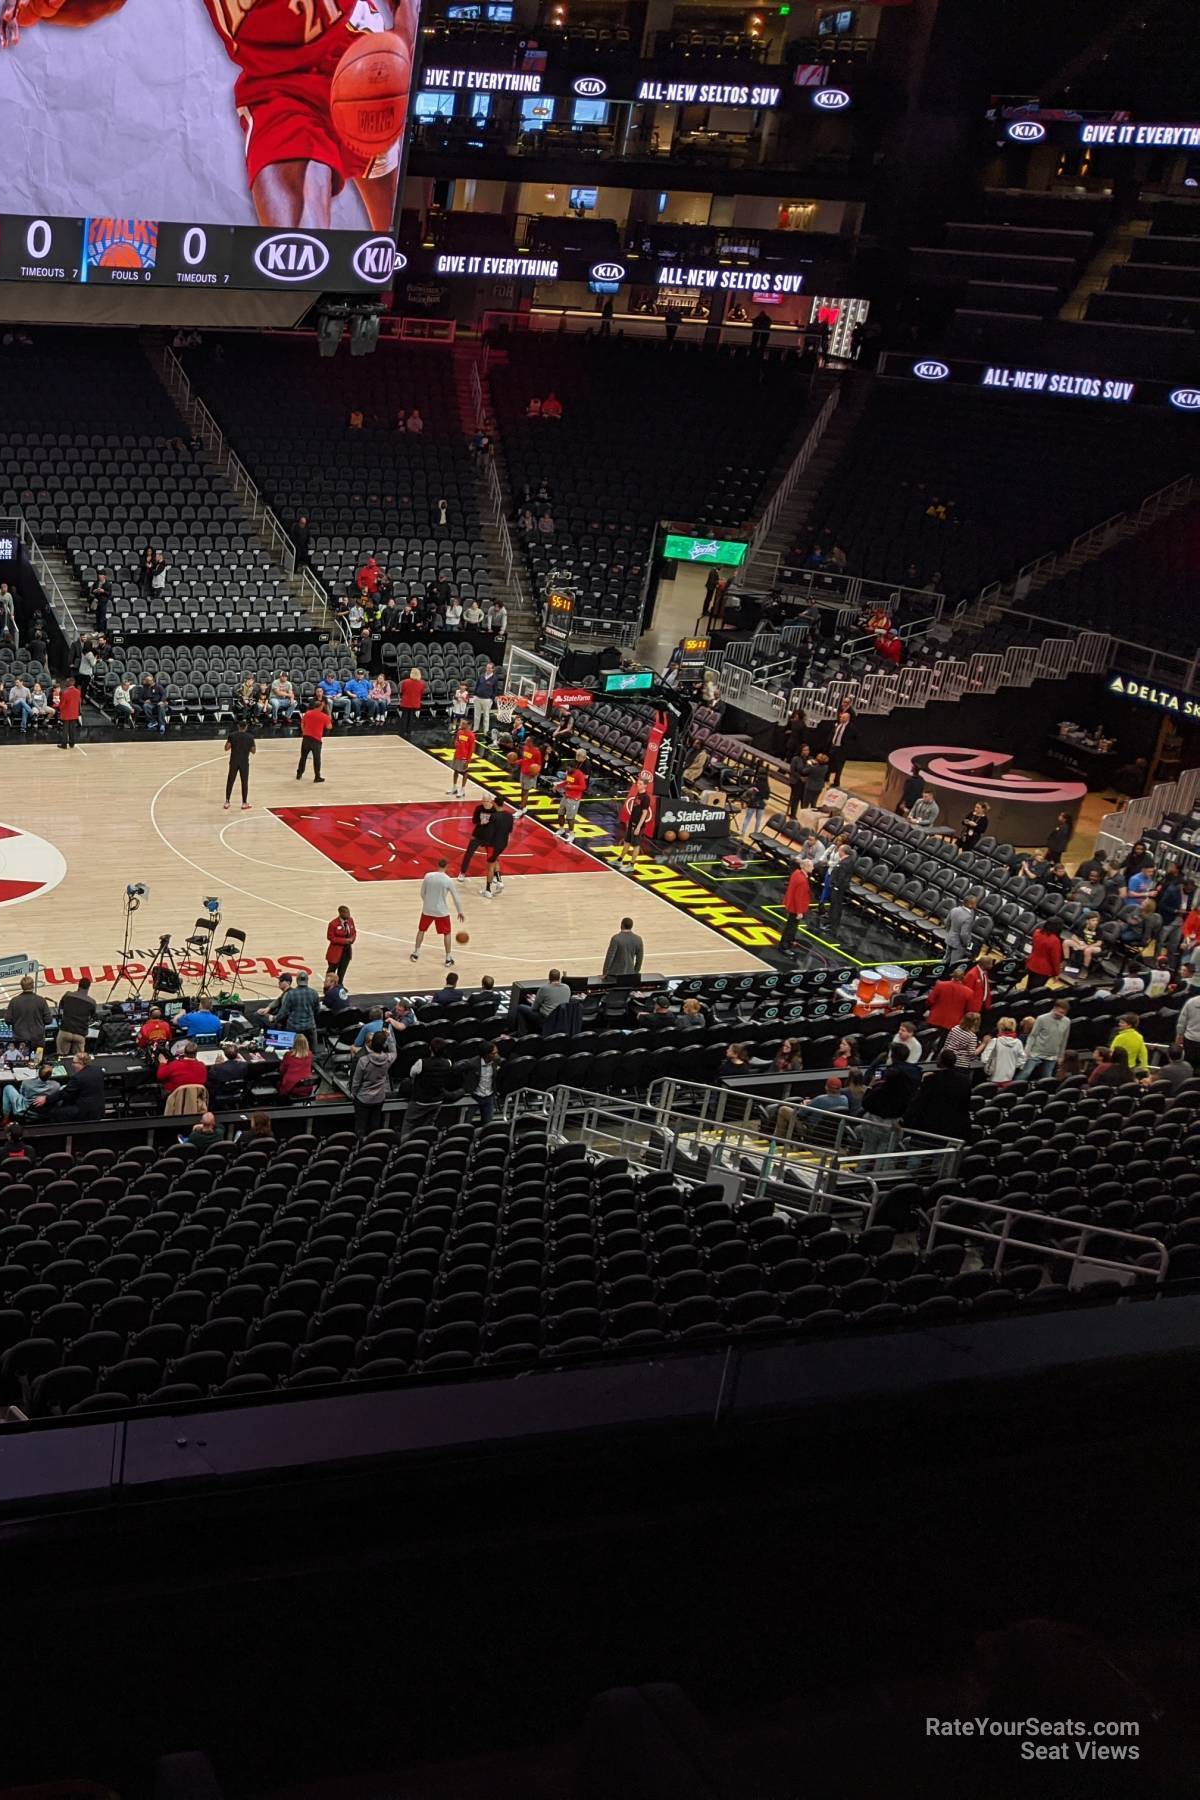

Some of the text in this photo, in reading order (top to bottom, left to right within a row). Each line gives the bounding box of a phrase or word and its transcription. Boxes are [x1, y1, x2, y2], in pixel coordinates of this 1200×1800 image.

[453, 70, 465, 88] IT
[467, 72, 541, 92] EVERYTHING
[639, 82, 780, 106] ALL-NEW SELTOS SUV
[1082, 125, 1117, 143] GIVE
[1118, 126, 1134, 143] IT
[26, 220, 52, 259] 0
[183, 227, 207, 264] 0
[21, 267, 79, 278] TIMEOUTS 7
[112, 270, 151, 281] FOULS 0
[438, 256, 558, 277] GIVE IT EVERYTHING
[177, 273, 230, 284] TIMEOUTS 7
[658, 267, 803, 292] ALL-NEW SELTOS SUV
[983, 368, 1134, 400] ALL-NEW SELTOS SUV
[552, 595, 571, 611] 55:11
[687, 640, 706, 649] 55:11
[562, 694, 591, 703] StateFarm
[1126, 682, 1179, 710] DELTA
[676, 809, 726, 822] StateFarm
[679, 823, 706, 832] ARENA
